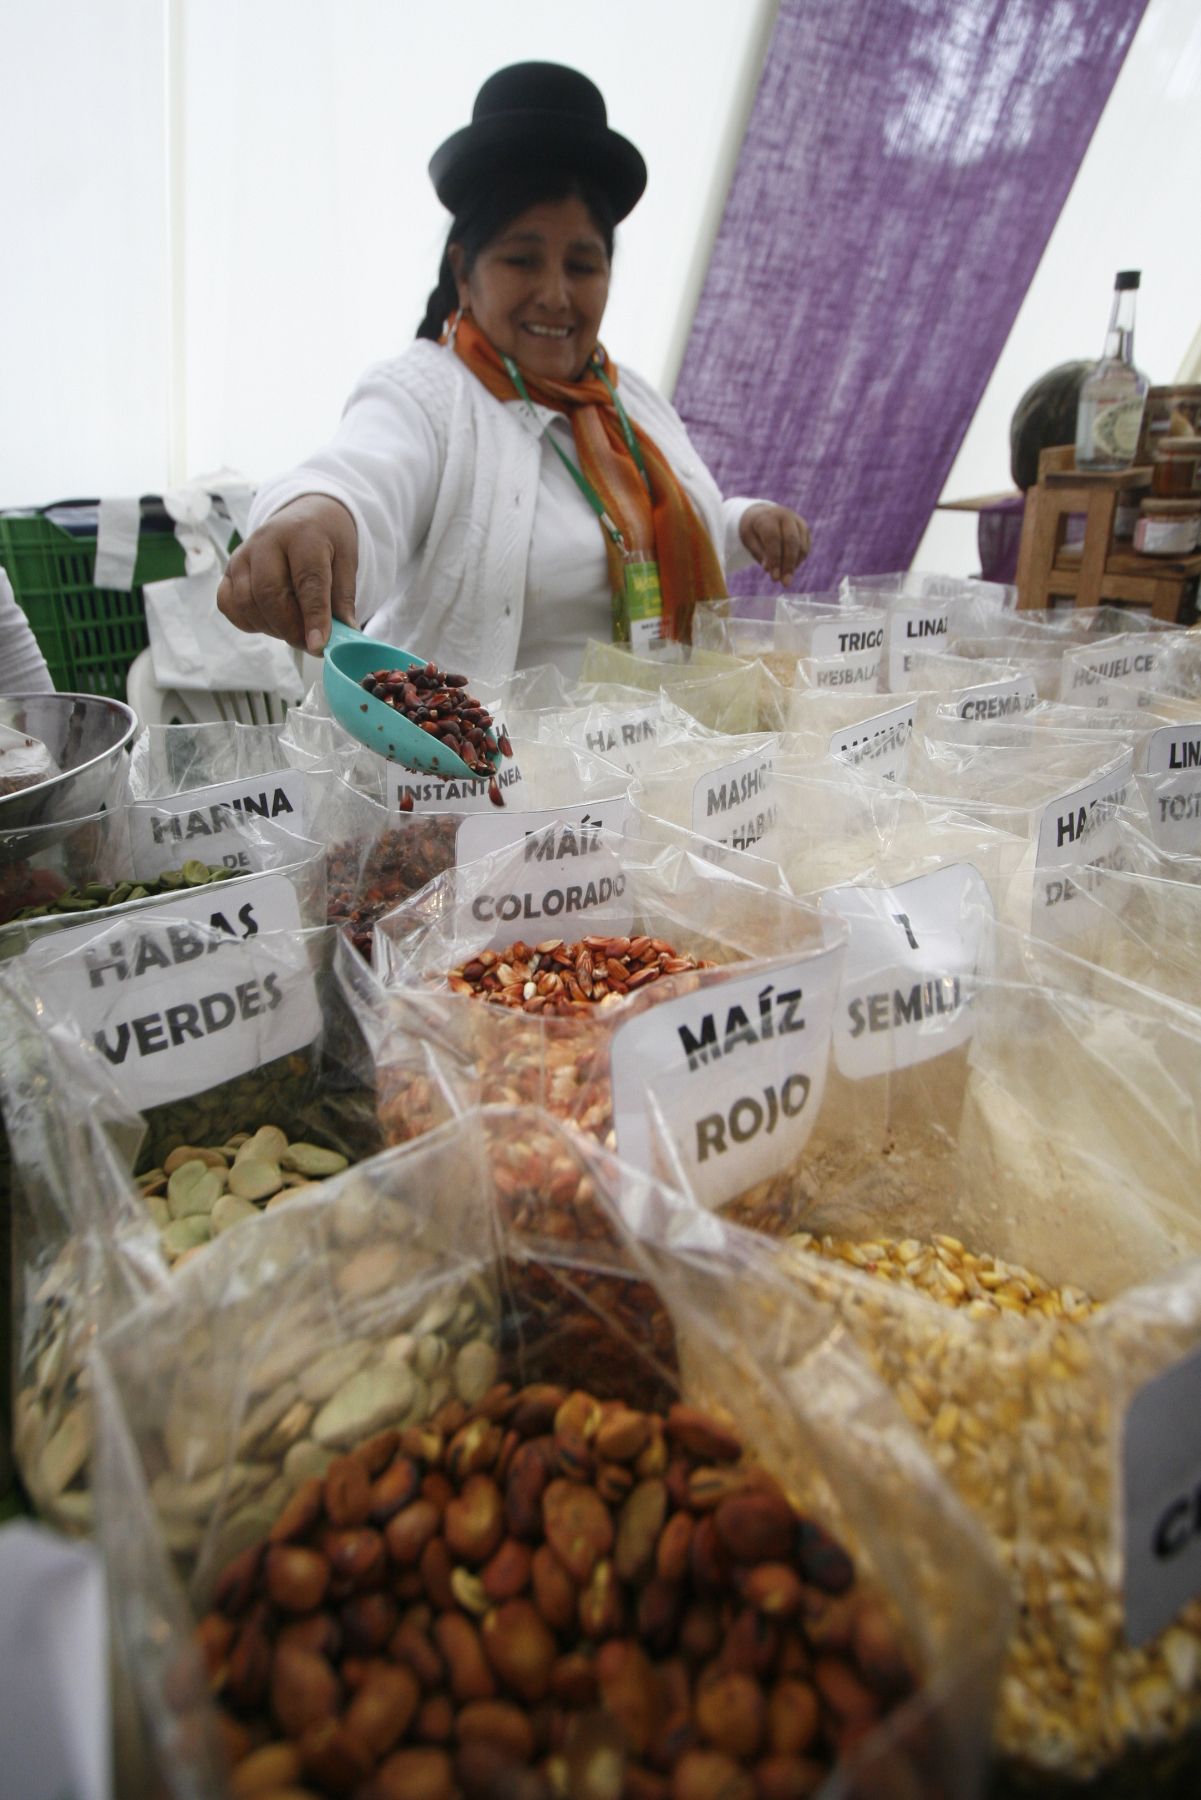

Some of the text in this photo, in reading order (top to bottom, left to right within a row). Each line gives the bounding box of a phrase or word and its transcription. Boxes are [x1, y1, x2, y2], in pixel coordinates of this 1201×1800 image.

[838, 628, 884, 652] TRIGO
[585, 714, 659, 752] HARIN
[1169, 741, 1201, 769] LIN
[397, 766, 522, 802] INSTANTNEA
[150, 788, 294, 845] HARINA
[524, 814, 603, 864] MAÍZ
[222, 852, 250, 869] DE
[472, 874, 626, 922] COLORADO
[84, 902, 259, 988] HABAS
[94, 971, 283, 1065] VERDES
[677, 985, 805, 1071] MAÍZ
[697, 1074, 810, 1164] ROJO
